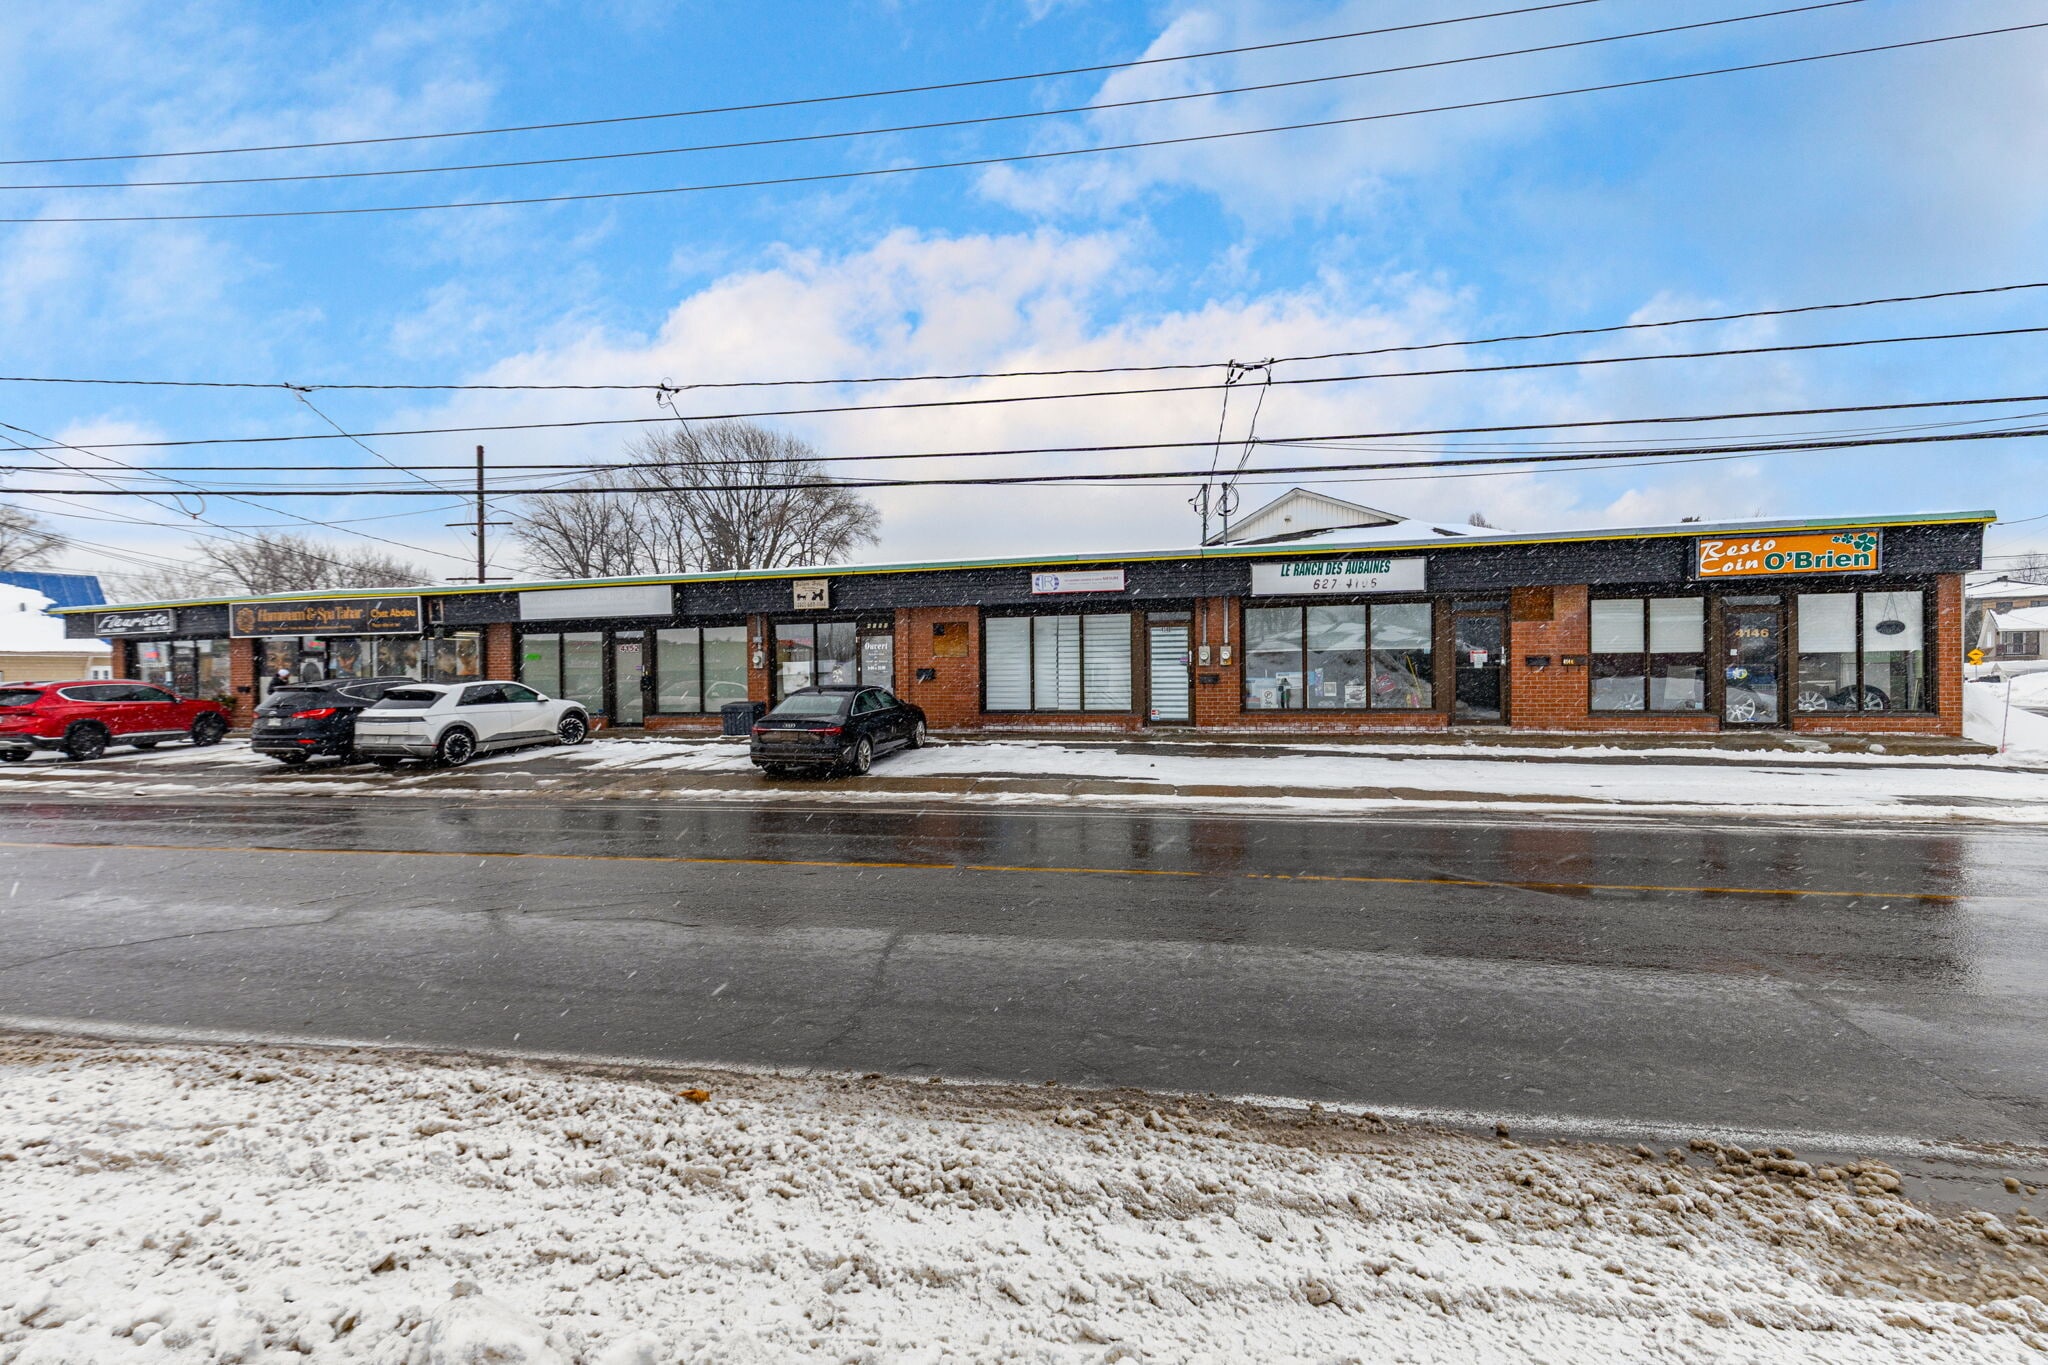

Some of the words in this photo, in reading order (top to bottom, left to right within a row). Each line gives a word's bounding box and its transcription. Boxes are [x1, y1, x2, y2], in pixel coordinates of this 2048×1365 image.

[1701, 539, 1776, 559] Resto
[1280, 563, 1290, 577] LE
[1293, 562, 1322, 576] RANCH
[1325, 561, 1342, 575] DES
[1345, 559, 1391, 574] AUBAINES
[1700, 557, 1759, 573] Coin
[1763, 549, 1871, 571] O'Brien
[1313, 578, 1337, 590] 627
[306, 607, 316, 620] &
[317, 606, 335, 624] Spa
[389, 607, 416, 617] Abdou
[98, 613, 169, 629] Fleuriste
[1735, 628, 1770, 638] 4146
